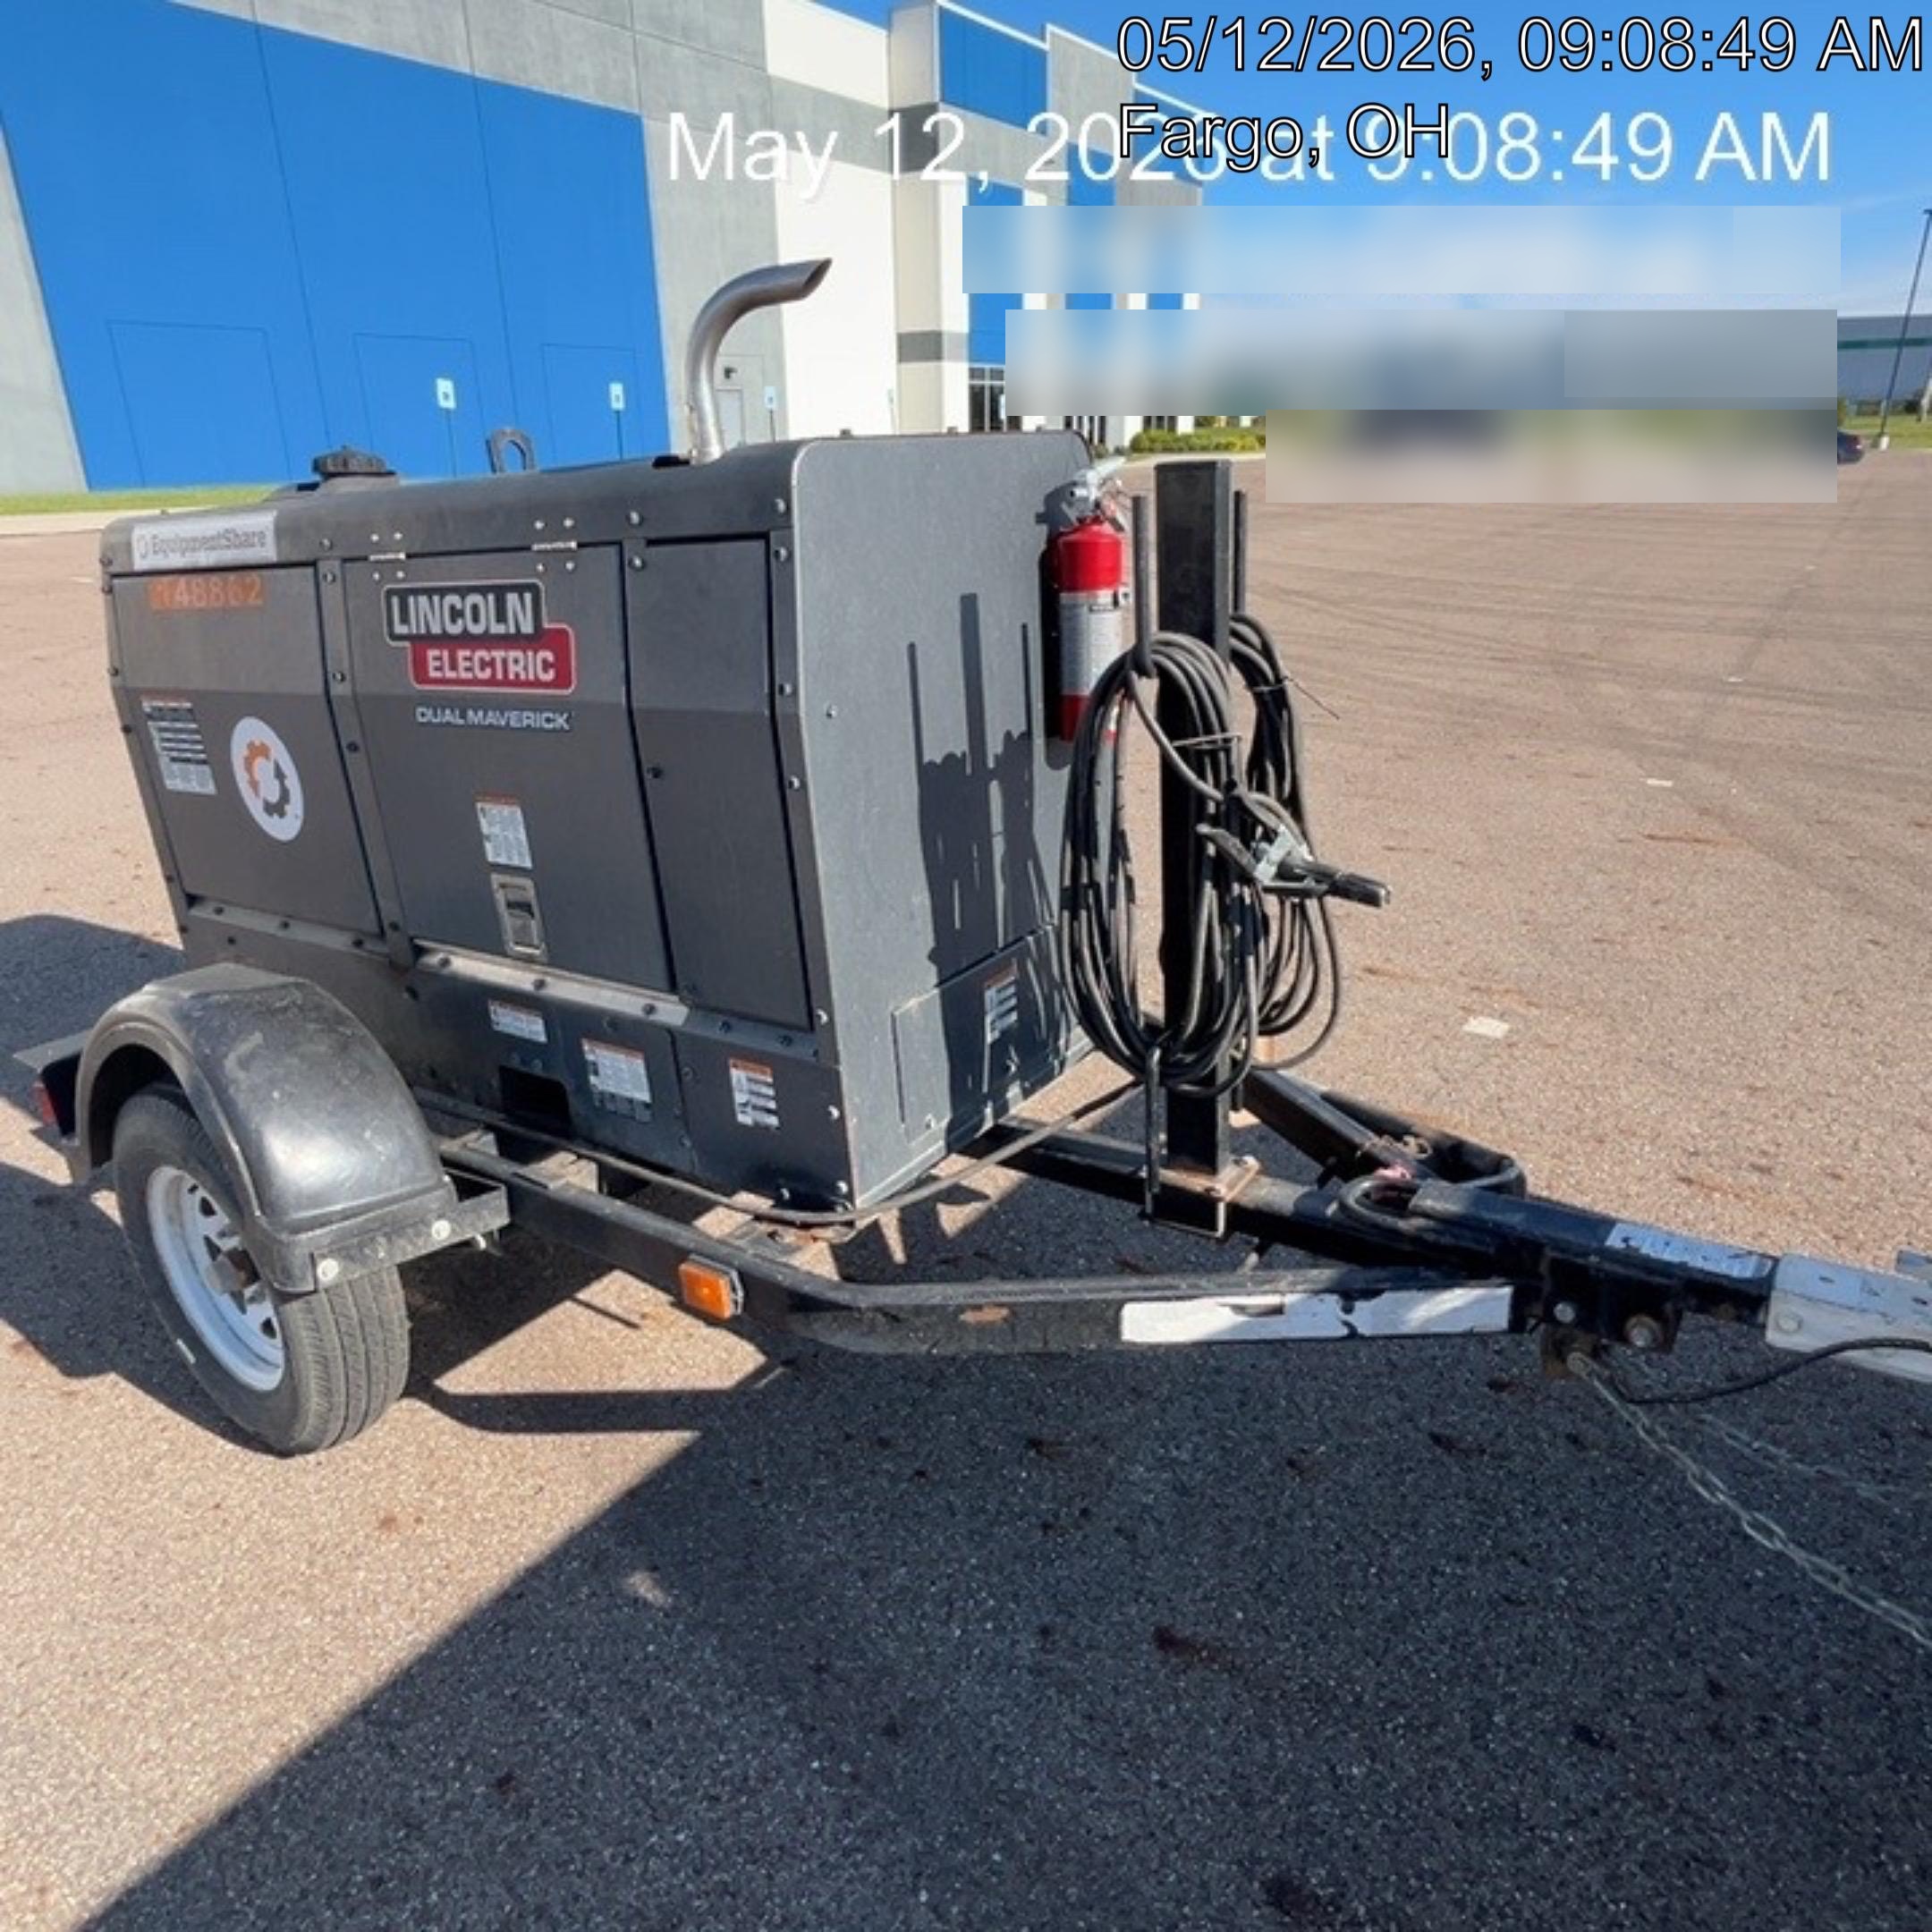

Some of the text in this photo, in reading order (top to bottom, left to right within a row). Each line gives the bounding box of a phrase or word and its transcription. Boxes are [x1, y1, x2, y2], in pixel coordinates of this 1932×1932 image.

[390, 591, 535, 635] LINCOLN
[425, 648, 556, 683] ELECTRIC
[414, 707, 571, 731] DUAL MAVERICK
